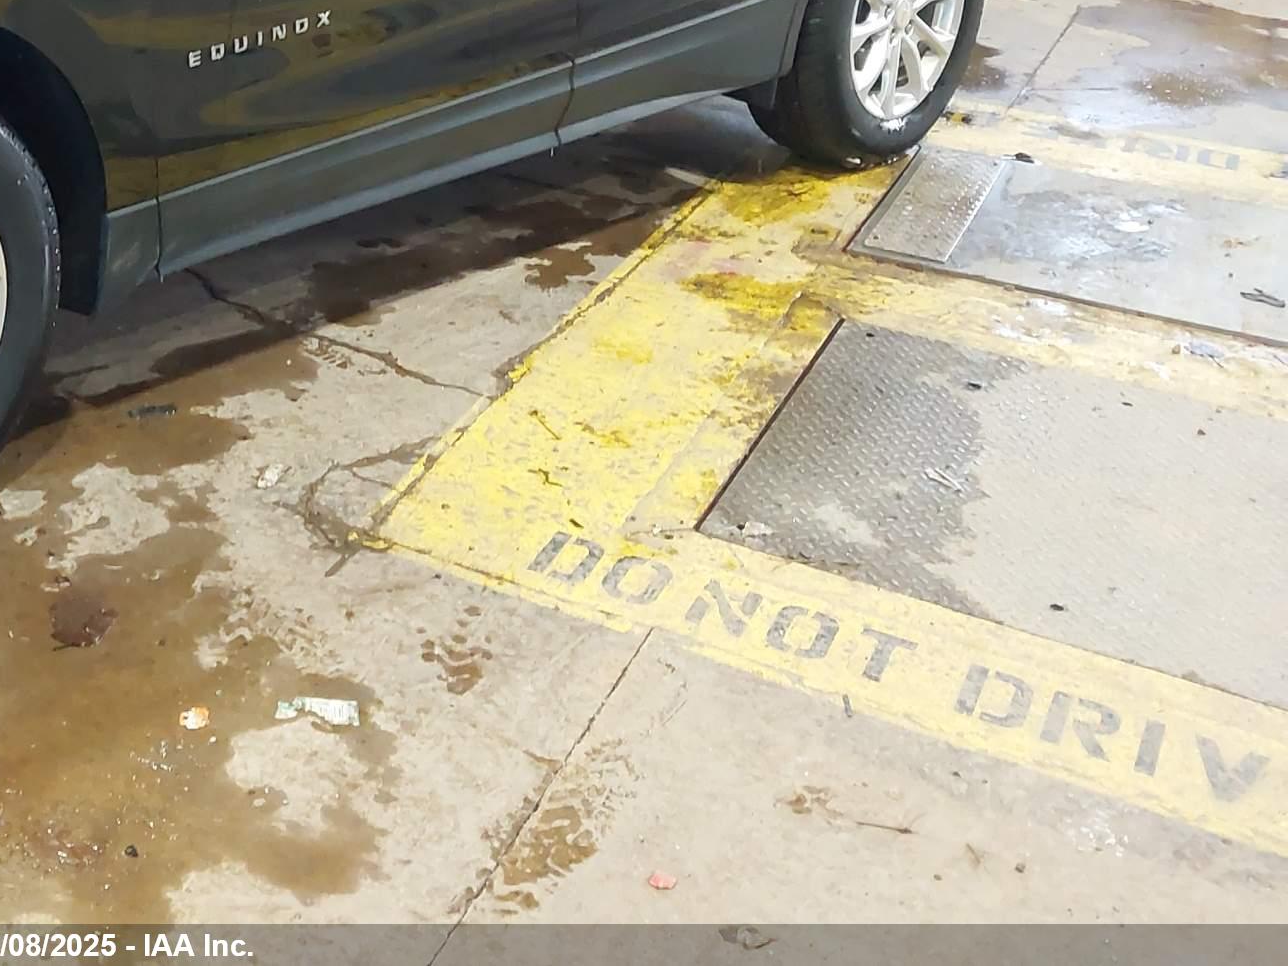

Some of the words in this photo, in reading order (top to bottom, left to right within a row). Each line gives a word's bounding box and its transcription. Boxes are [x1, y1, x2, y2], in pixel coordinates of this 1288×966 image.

[188, 9, 332, 69] EQUINOX
[527, 531, 675, 605] DO
[684, 578, 918, 683] NOT
[953, 663, 1270, 802] DRIV
